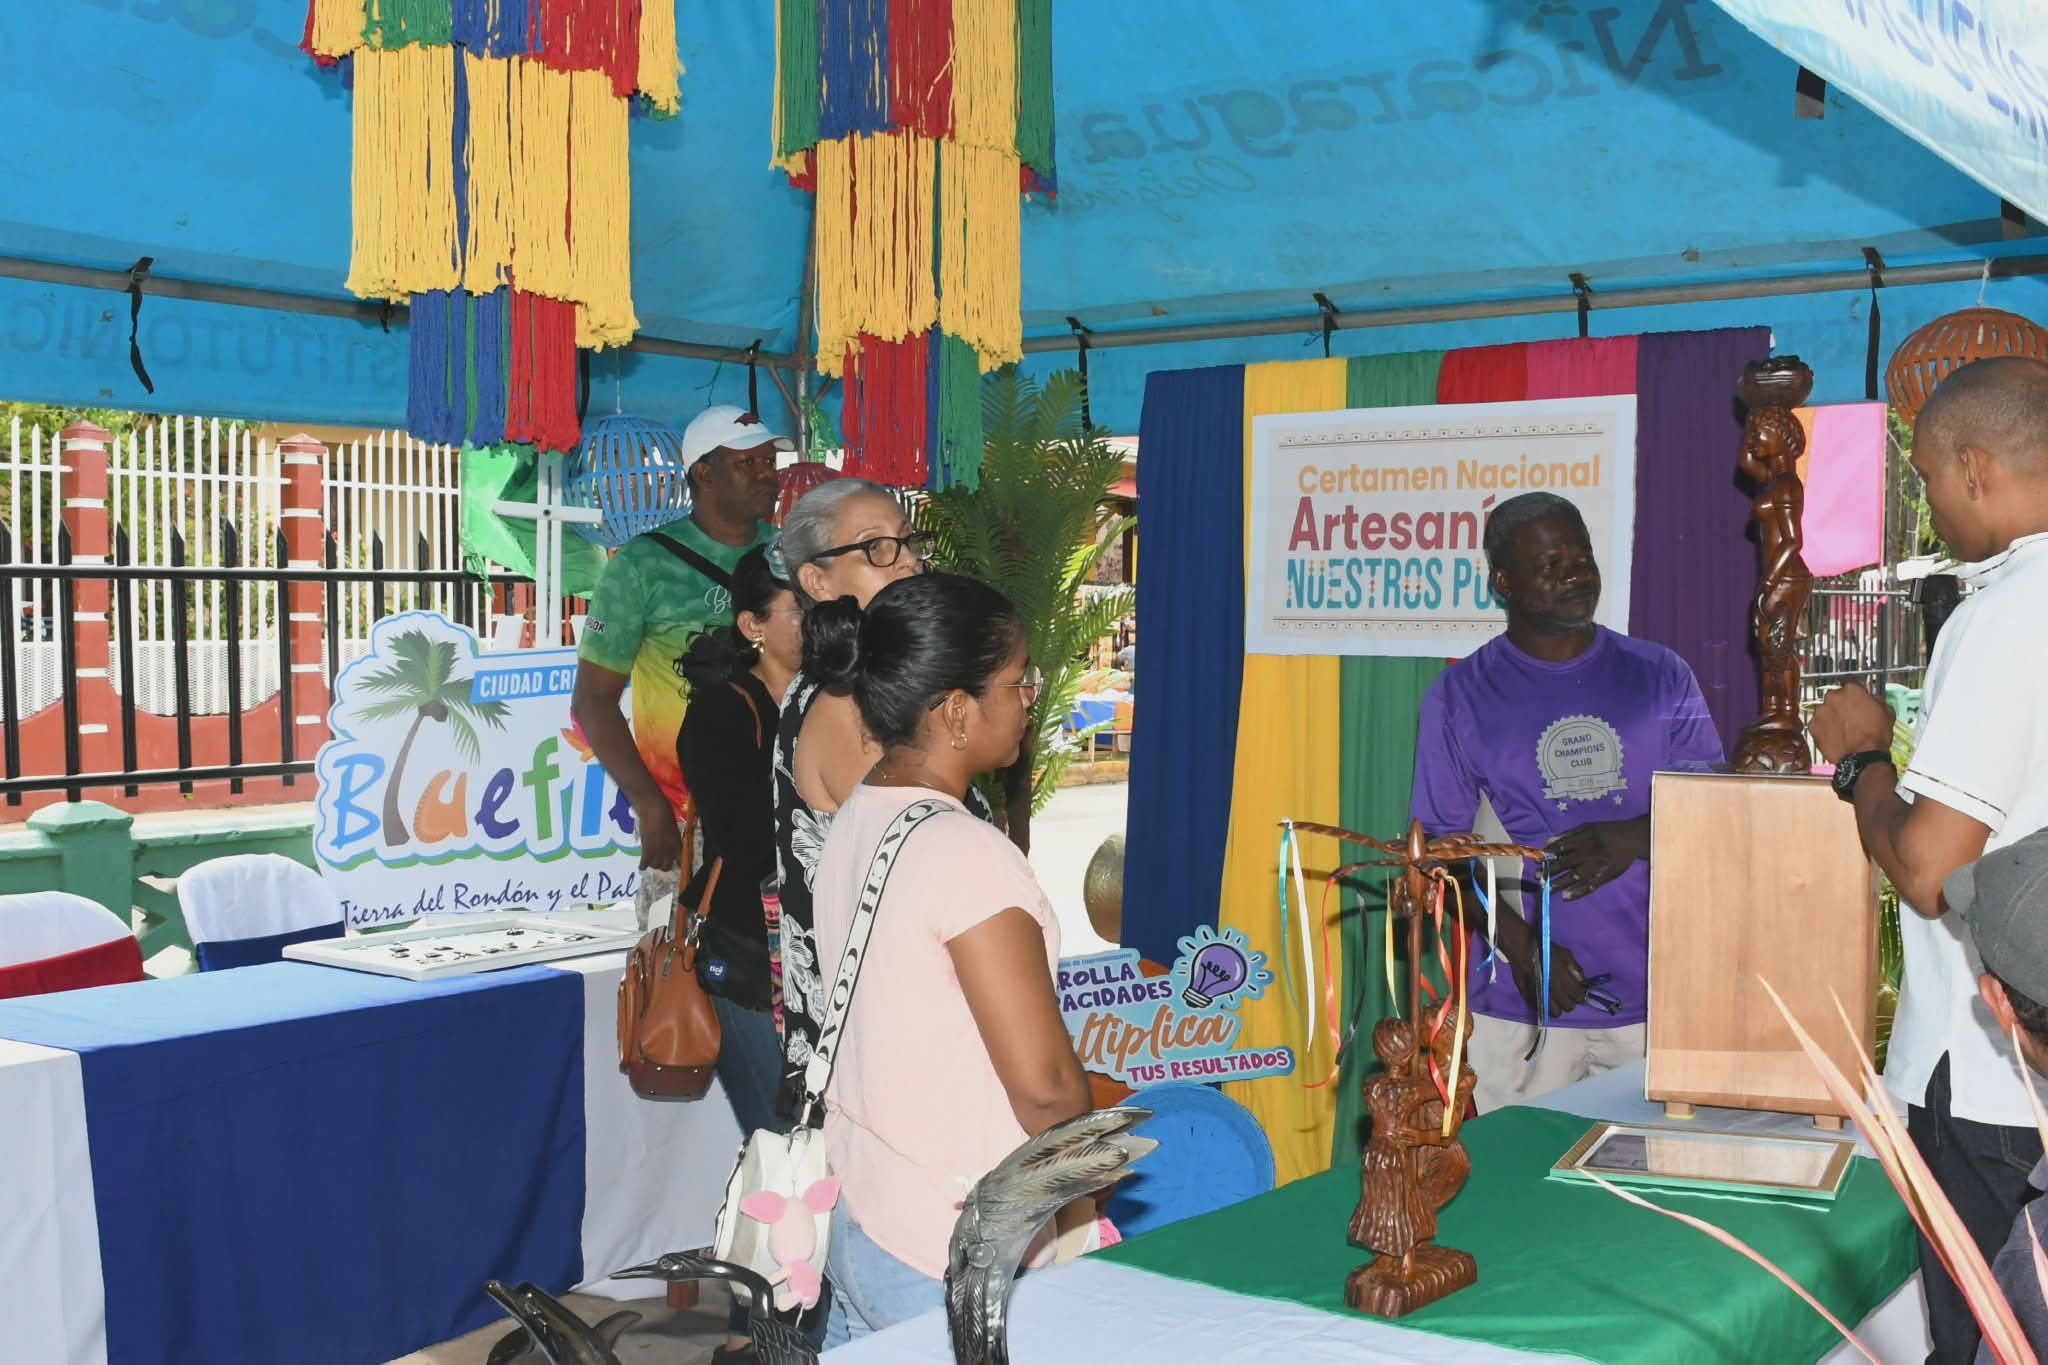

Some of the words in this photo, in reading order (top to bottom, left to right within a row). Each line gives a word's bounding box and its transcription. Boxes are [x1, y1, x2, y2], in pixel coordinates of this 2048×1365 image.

[1298, 464, 1448, 495] Certamen
[1457, 454, 1600, 490] Nacional
[1288, 494, 1496, 551] Artesaní
[1286, 557, 1442, 610] NUESTROS
[1453, 557, 1507, 611] PU
[480, 671, 543, 697] CIUDAD
[1554, 743, 1605, 758] CHAMPIONS
[1562, 734, 1592, 746] GRAND
[1570, 757, 1593, 768] CLUB
[341, 901, 403, 926] Tierra
[412, 885, 444, 914] del
[454, 879, 539, 910] Rondón
[546, 889, 562, 911] y
[571, 873, 589, 899] el
[597, 871, 639, 900] Pal
[1057, 962, 1136, 991] ROLLA
[1057, 981, 1173, 1012] ACIDADES
[1071, 1004, 1234, 1073] ltiplica
[1126, 1065, 1166, 1083] TUS
[1170, 1051, 1288, 1080] RESULTADOS
